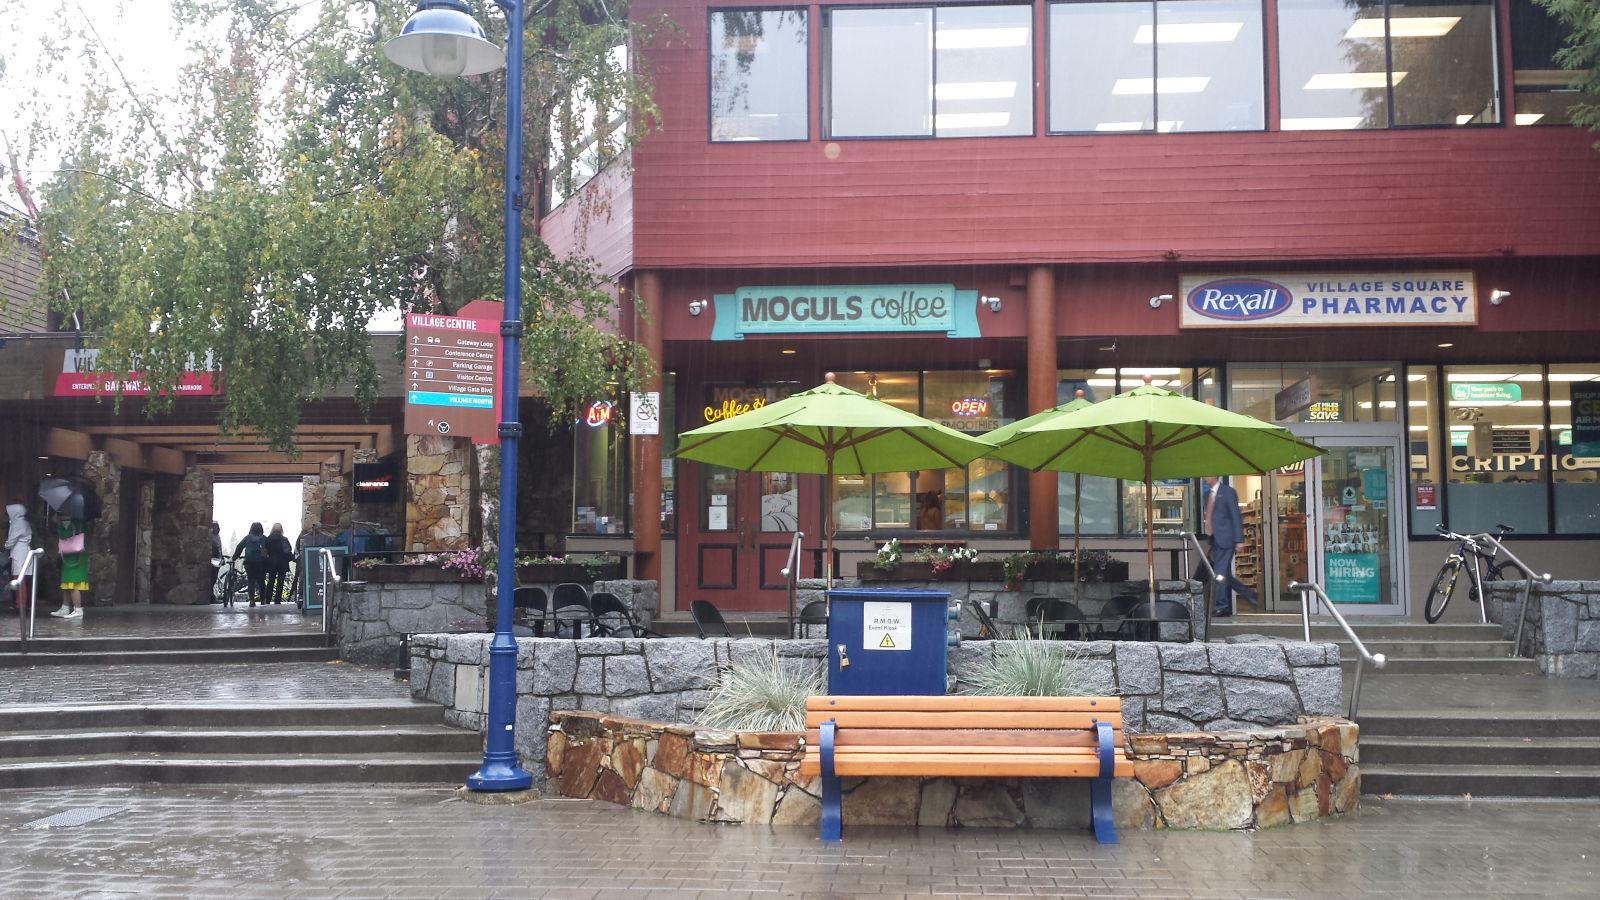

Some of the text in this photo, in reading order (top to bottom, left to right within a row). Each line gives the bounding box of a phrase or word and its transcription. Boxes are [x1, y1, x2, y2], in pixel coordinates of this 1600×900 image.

[1306, 280, 1465, 293] VILLAGE SQUARE
[1201, 288, 1278, 315] Rexall
[1303, 297, 1467, 314] PHARMACY
[742, 290, 948, 326] MOGULS coffee
[412, 316, 477, 330] VILLAGE CENTRE
[457, 338, 494, 348] Gateway Loop
[444, 349, 475, 359] Conference
[452, 361, 493, 371] Parking Garage
[456, 373, 474, 381] Visitor
[448, 385, 467, 393] Village
[704, 399, 750, 422] Coffee
[951, 401, 988, 413] OPEN
[588, 405, 611, 421] ATM
[1309, 411, 1340, 420] save
[940, 420, 999, 430] SMOOTHIES
[1329, 558, 1357, 567] NOW
[1329, 567, 1375, 578] HIRING
